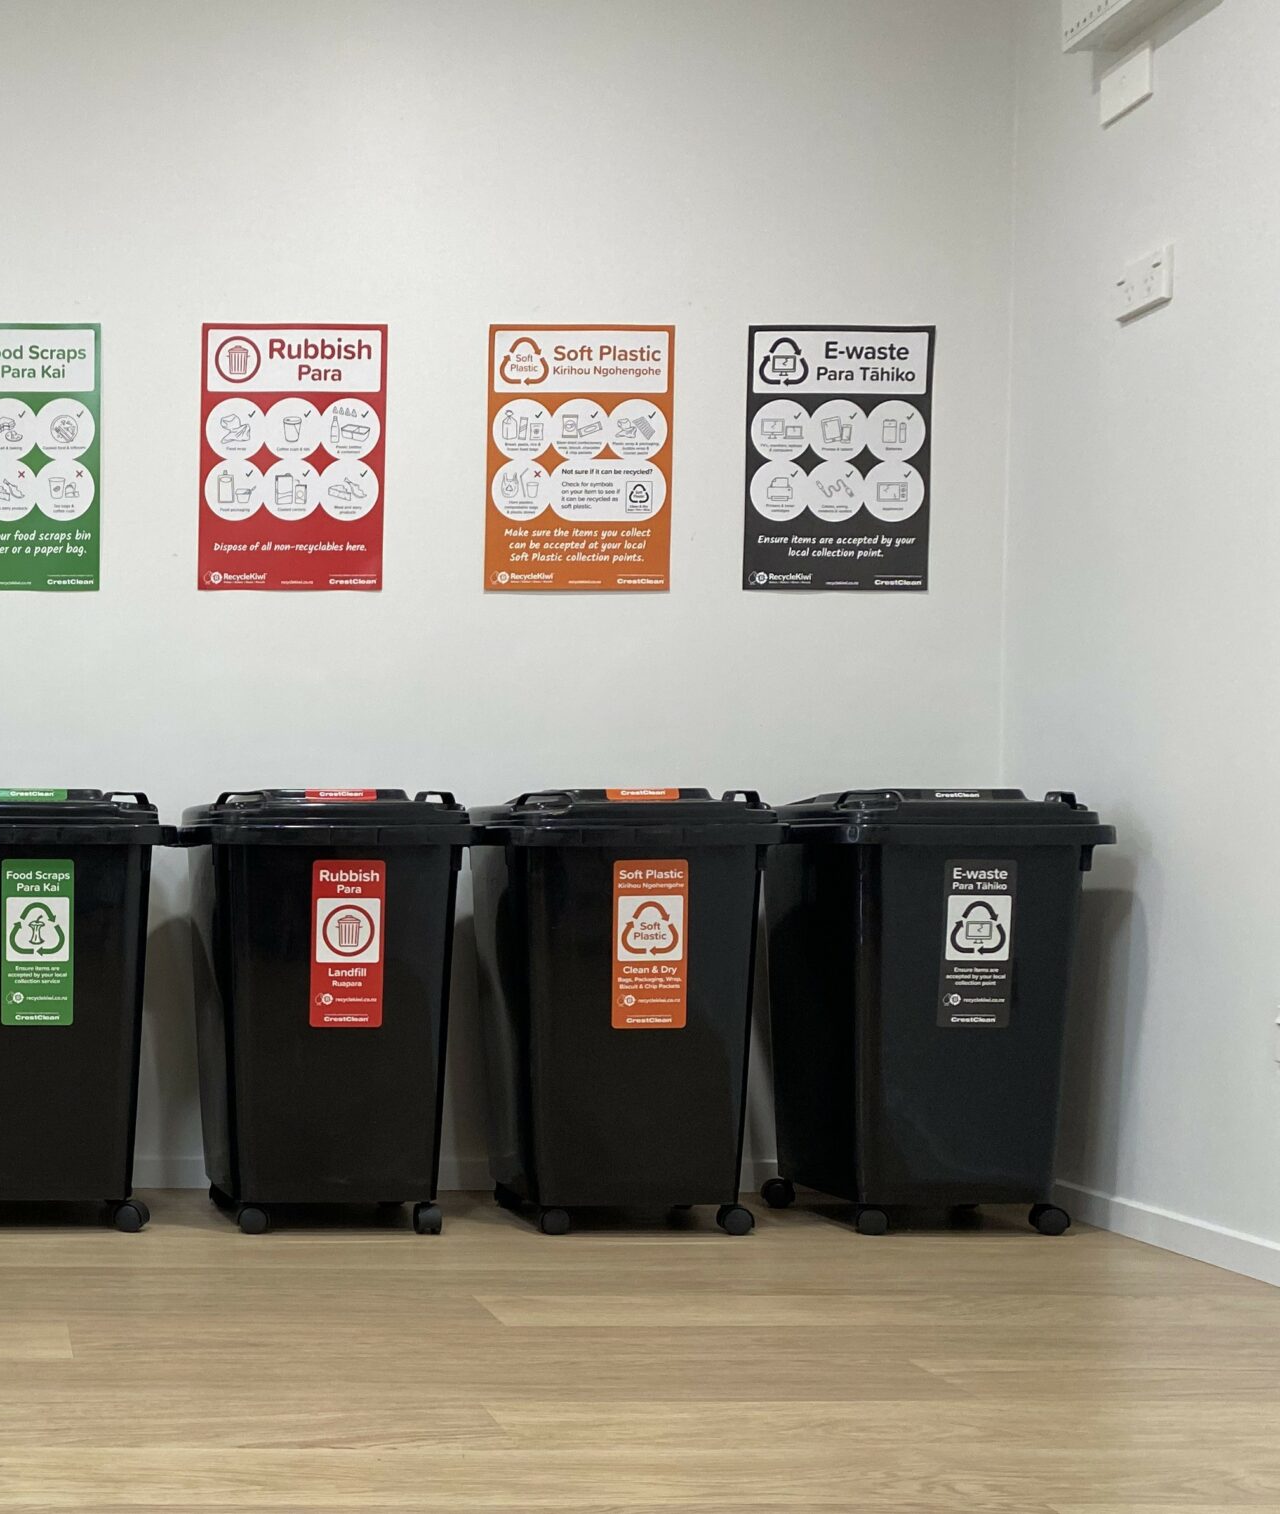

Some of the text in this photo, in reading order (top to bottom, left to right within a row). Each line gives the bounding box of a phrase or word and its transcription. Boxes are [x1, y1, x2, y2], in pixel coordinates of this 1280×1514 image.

[28, 345, 87, 363] Scraps
[268, 337, 372, 360] Rubbish
[553, 345, 661, 362] Soft Plastic
[824, 341, 910, 361] E-waste
[1, 364, 65, 379] Para Kai
[298, 364, 342, 382] Para
[553, 366, 662, 378] Kirihou Ngohengohe
[816, 366, 916, 382] Para Tāhiko
[13, 530, 37, 541] food
[38, 532, 72, 545] scraps
[74, 529, 92, 540] bin
[504, 526, 529, 537] Make
[553, 527, 570, 537] the
[571, 528, 598, 537] items
[600, 530, 618, 540] you
[620, 527, 651, 537] collect
[213, 541, 367, 554] Dispose of all non-recyclables here.
[529, 539, 541, 549] be
[543, 539, 586, 552] accepted
[588, 541, 599, 549] at
[600, 542, 622, 552] your
[623, 539, 646, 549] local
[757, 535, 789, 544] Ensure
[791, 535, 817, 544] items
[836, 535, 879, 546] accepted
[880, 535, 893, 547] by
[894, 537, 916, 548] your
[11, 546, 23, 554] or
[33, 546, 64, 557] paper
[65, 542, 87, 557] bag.
[788, 546, 884, 560] local collection point.
[509, 551, 644, 564] Soft Plastic collection points.
[6, 870, 71, 882] Food Scraps
[319, 869, 380, 882] Rubbish
[619, 869, 684, 880] Soft Plastic
[953, 867, 1008, 880] E-waste
[16, 882, 60, 892] Para Kai
[336, 884, 362, 894] Para
[640, 922, 661, 931] Soft
[633, 932, 667, 940] Plastic
[328, 968, 367, 977] Landfill
[622, 965, 678, 975] Clean & Dry
[332, 980, 363, 988] Ruapara
